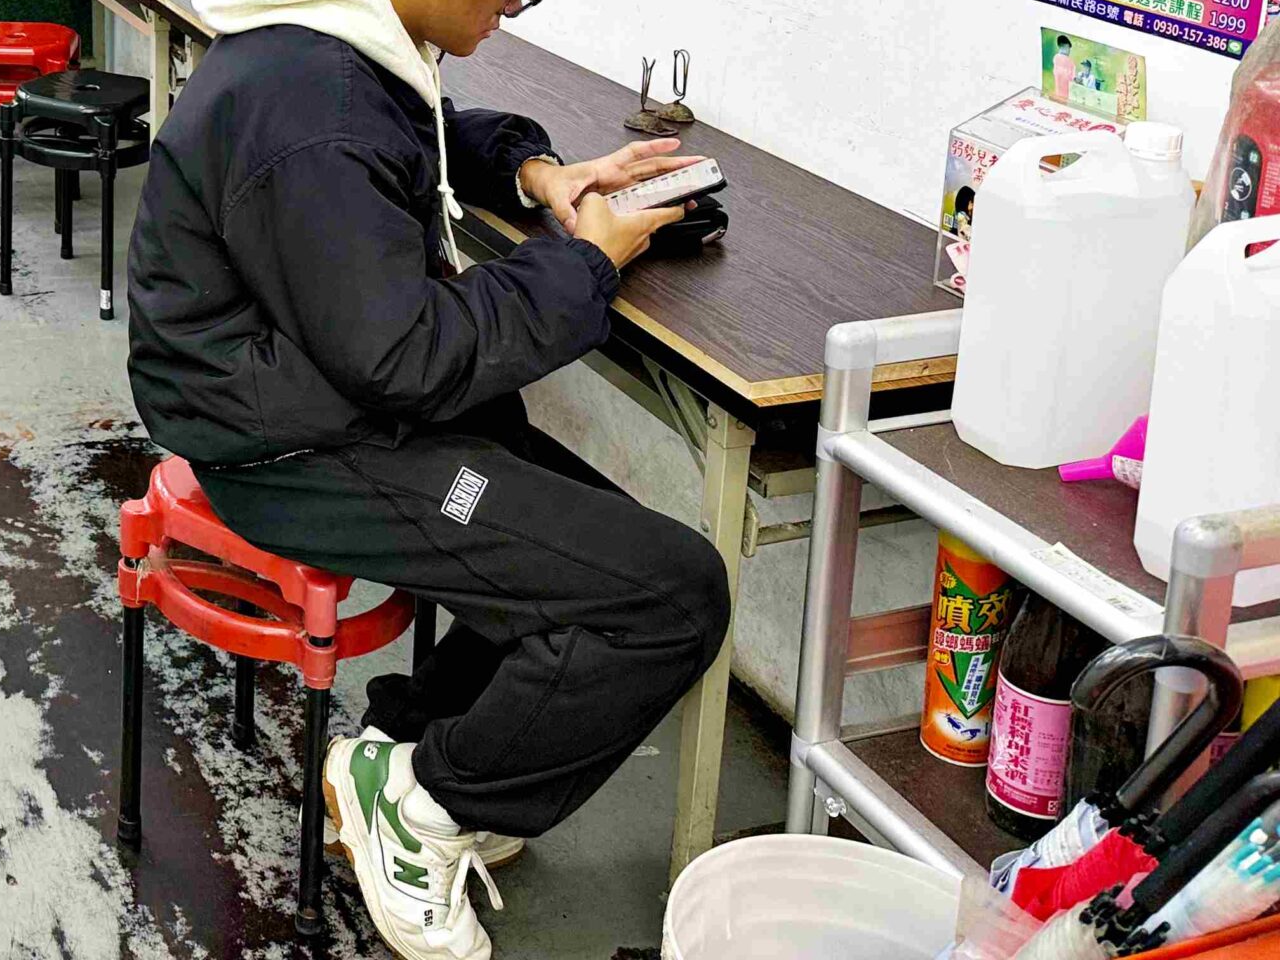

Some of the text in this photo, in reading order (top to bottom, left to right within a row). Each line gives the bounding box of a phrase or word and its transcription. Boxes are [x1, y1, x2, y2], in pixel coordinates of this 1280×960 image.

[1153, 17, 1227, 50] 0930-157-386
[1210, 12, 1246, 33] 1999
[446, 471, 484, 520] FASHION
